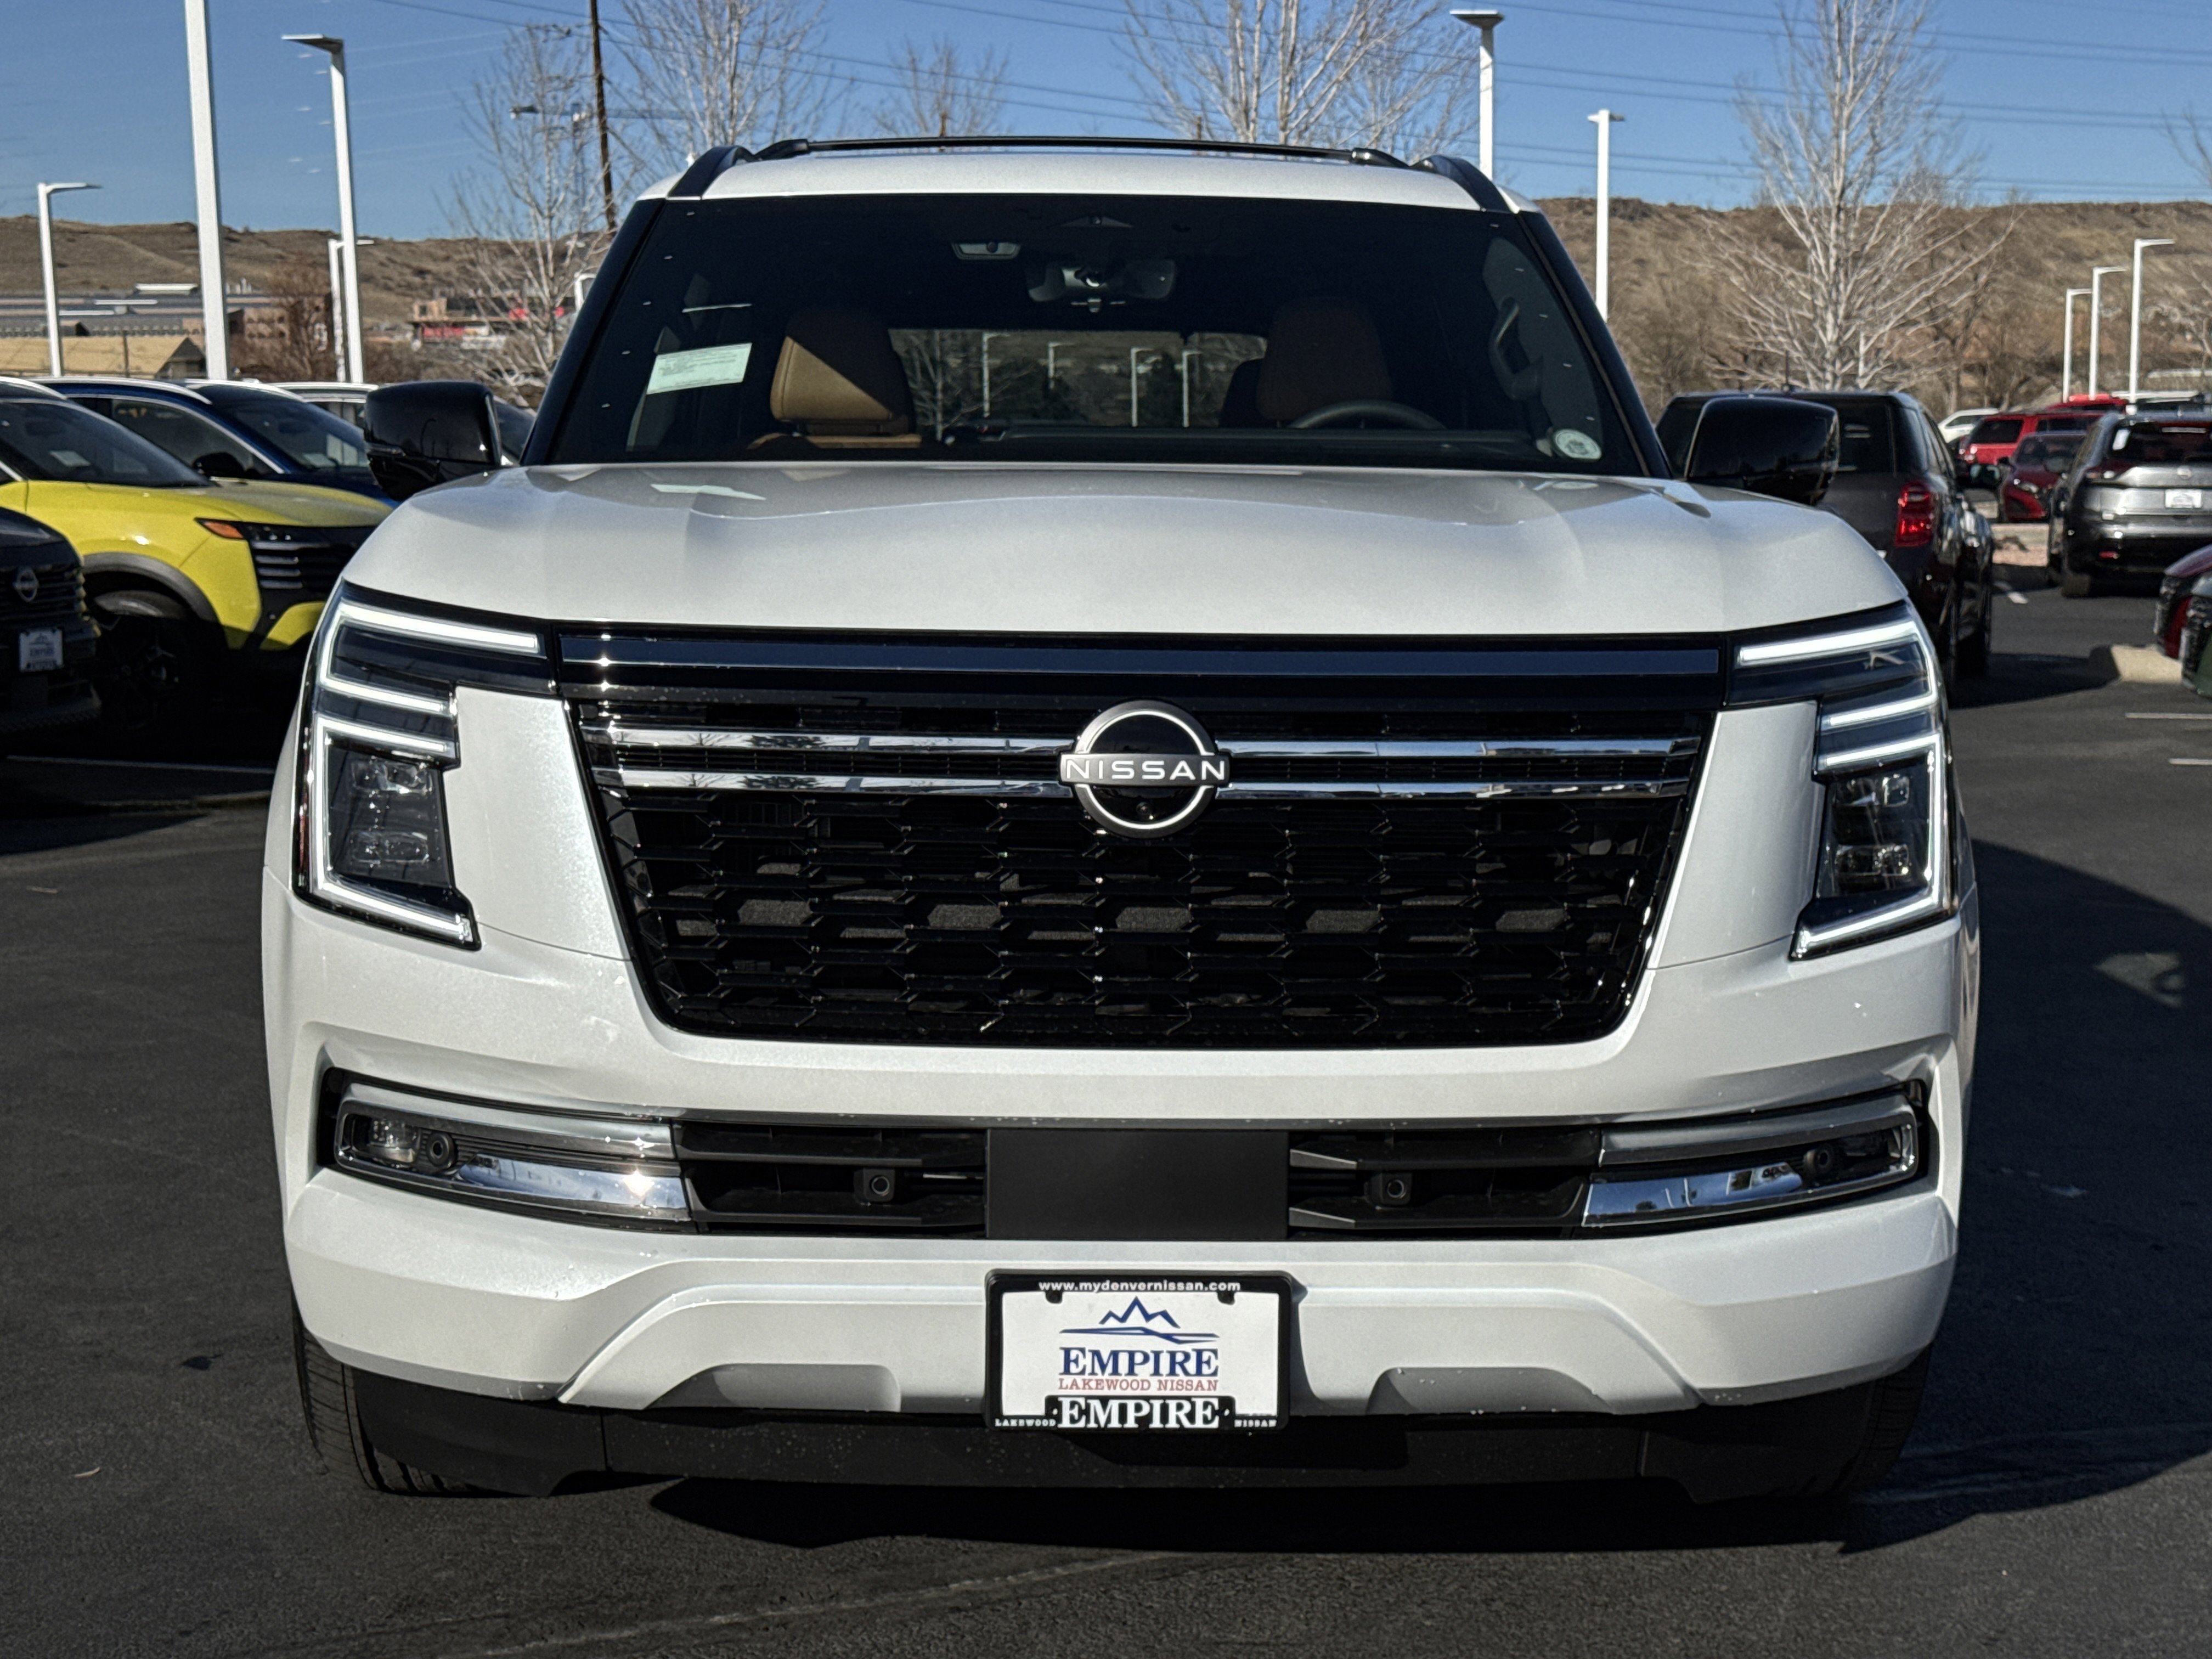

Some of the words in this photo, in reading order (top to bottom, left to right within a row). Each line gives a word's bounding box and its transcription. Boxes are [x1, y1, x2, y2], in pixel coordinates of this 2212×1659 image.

[1066, 760, 1225, 780] NISSAN
[1039, 1280, 1240, 1293] www.mydenvernissan.com
[1059, 1347, 1218, 1376] EMPIRE
[1058, 1378, 1151, 1391] LAKEWOOD
[1156, 1379, 1218, 1391] NISSAN
[995, 1418, 1056, 1427] LAKEWOOD
[1057, 1397, 1220, 1429] EMPIRE
